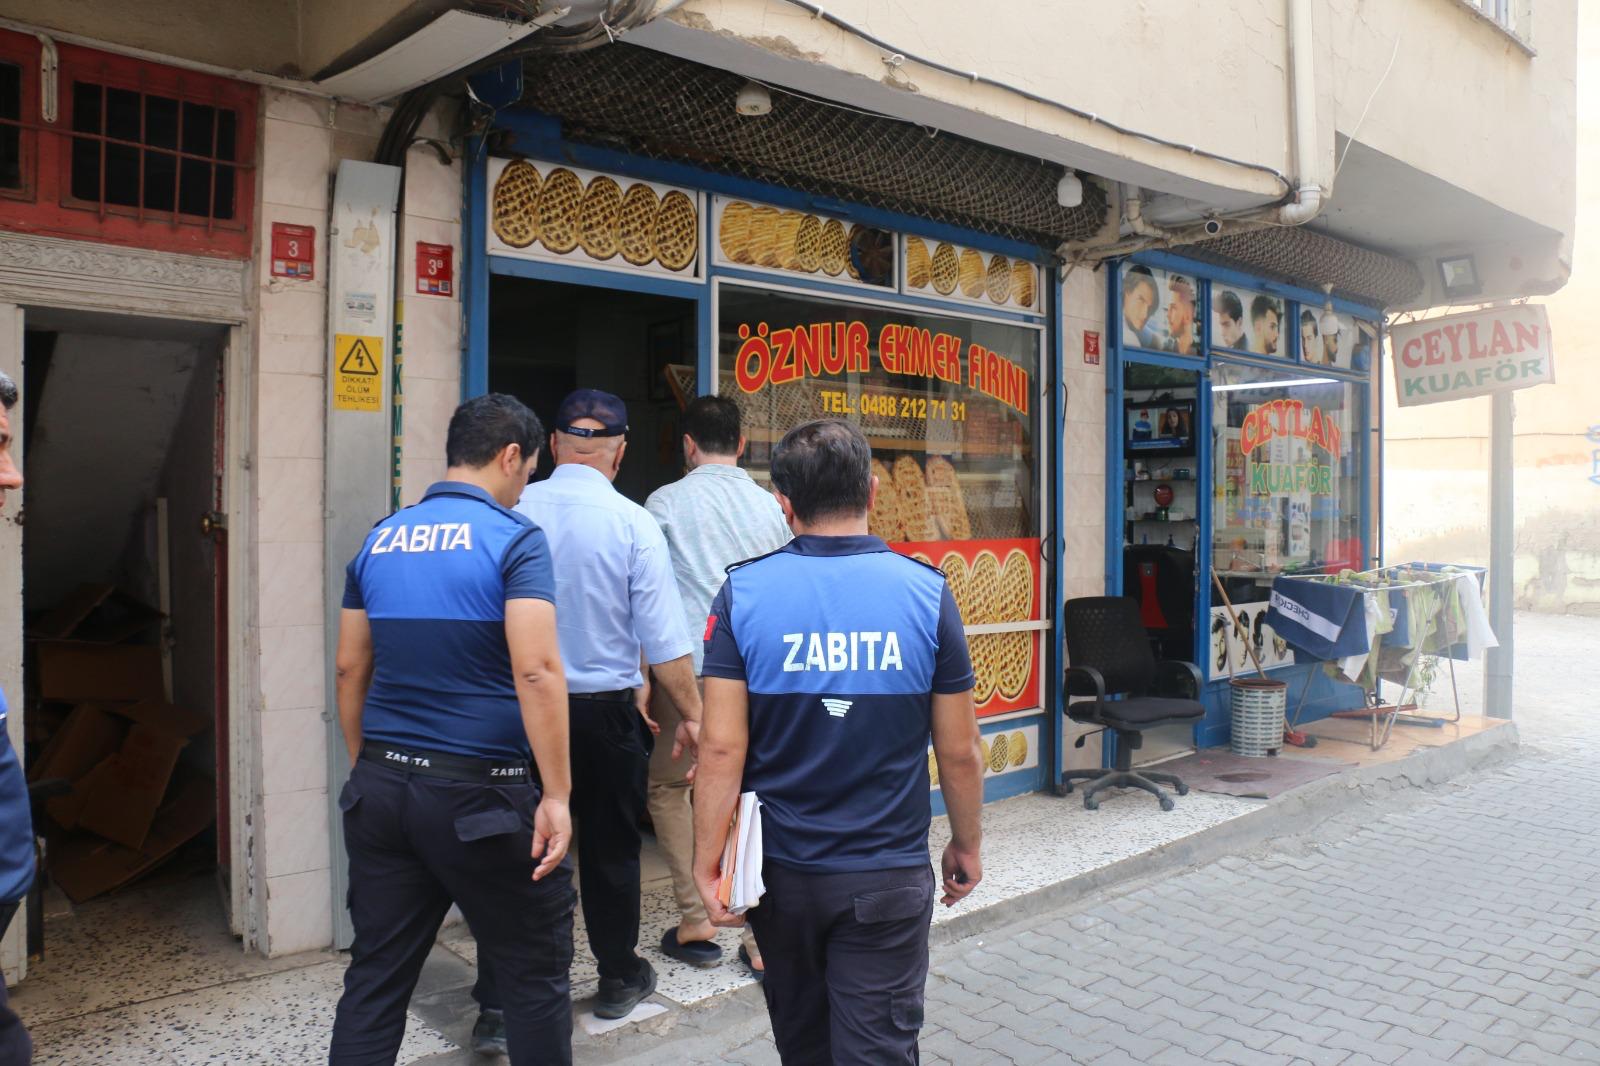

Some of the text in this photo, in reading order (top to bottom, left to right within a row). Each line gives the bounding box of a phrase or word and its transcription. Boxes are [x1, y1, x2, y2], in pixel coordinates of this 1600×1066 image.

[288, 240, 298, 258] 3
[1402, 319, 1540, 368] CEYLAN
[735, 320, 1029, 416] ÖZNUR EKMEK FIRINI
[1404, 356, 1545, 397] KUAFÖR
[821, 391, 966, 421] TEL: 0488 212 71 31
[1240, 399, 1341, 462] CEYLAN
[1250, 456, 1333, 496] KUAFÖR
[370, 523, 473, 555] ZABITA
[782, 631, 903, 672] ZABITA
